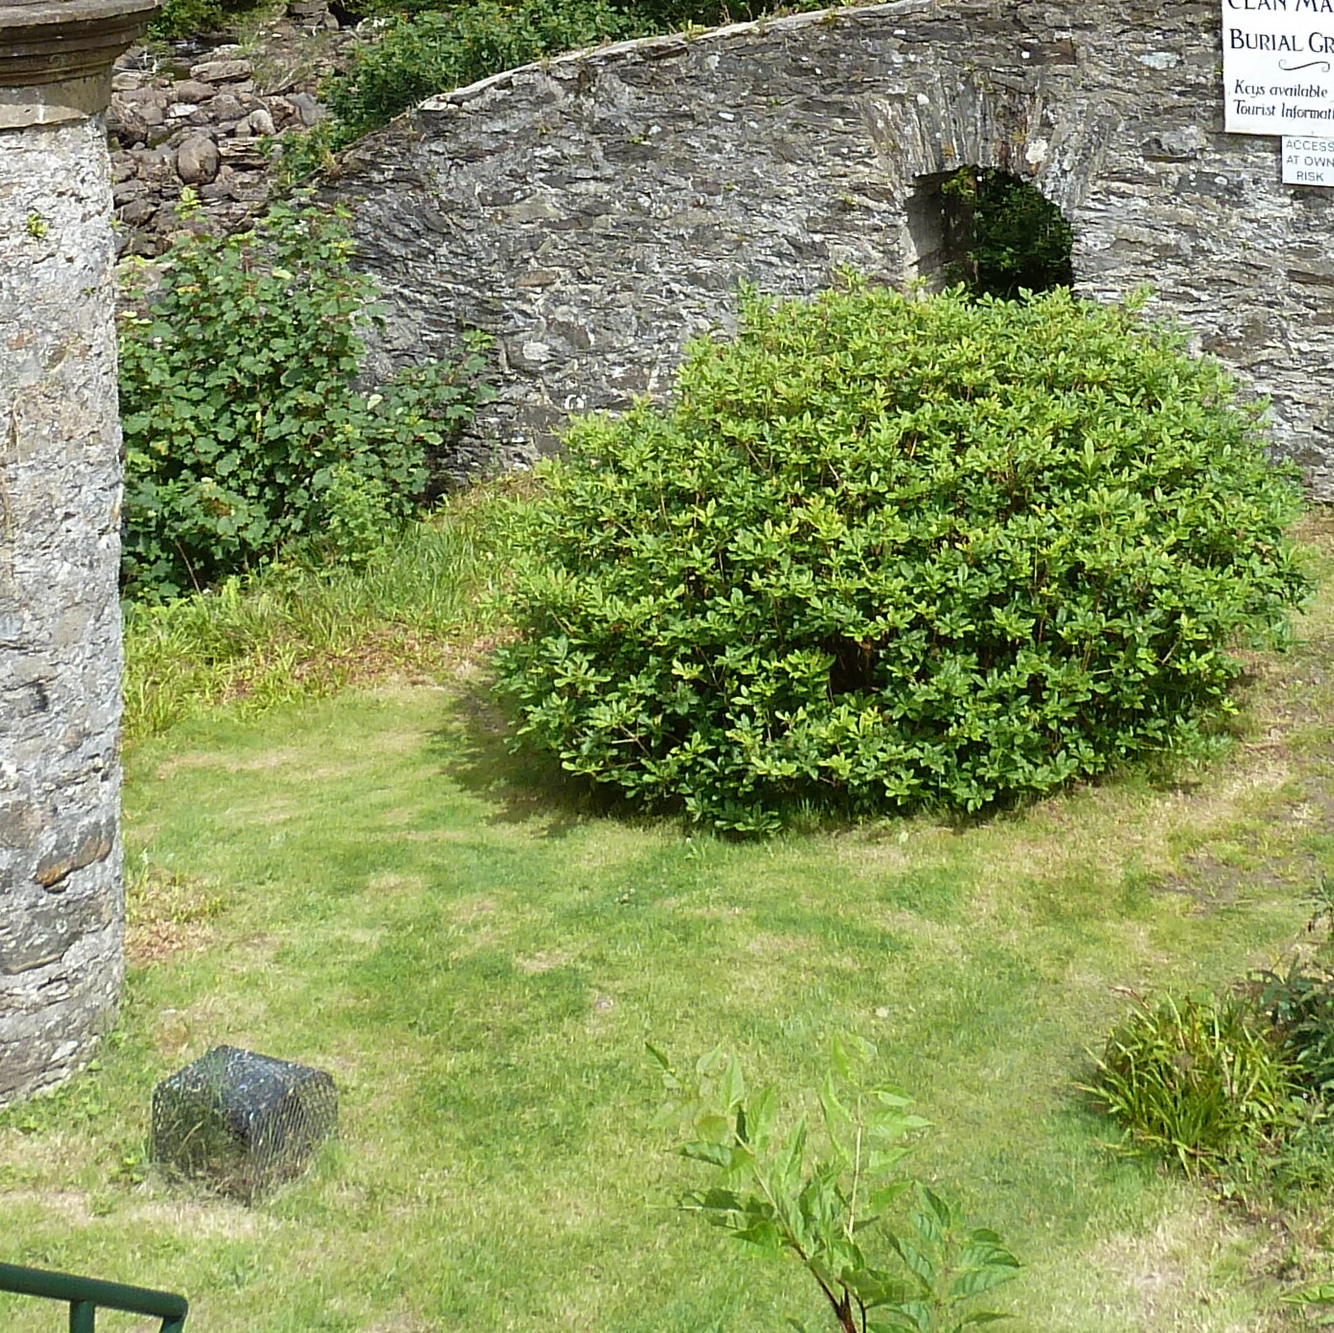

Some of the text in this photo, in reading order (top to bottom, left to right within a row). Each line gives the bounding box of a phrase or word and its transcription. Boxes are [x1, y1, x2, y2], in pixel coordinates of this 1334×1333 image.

[1230, 28, 1303, 52] BURIAL
[1234, 79, 1265, 98] Keys
[1269, 84, 1328, 98] available
[1233, 99, 1276, 116] Tourist
[1286, 155, 1334, 167] AT OWN
[1296, 171, 1324, 182] RISK
